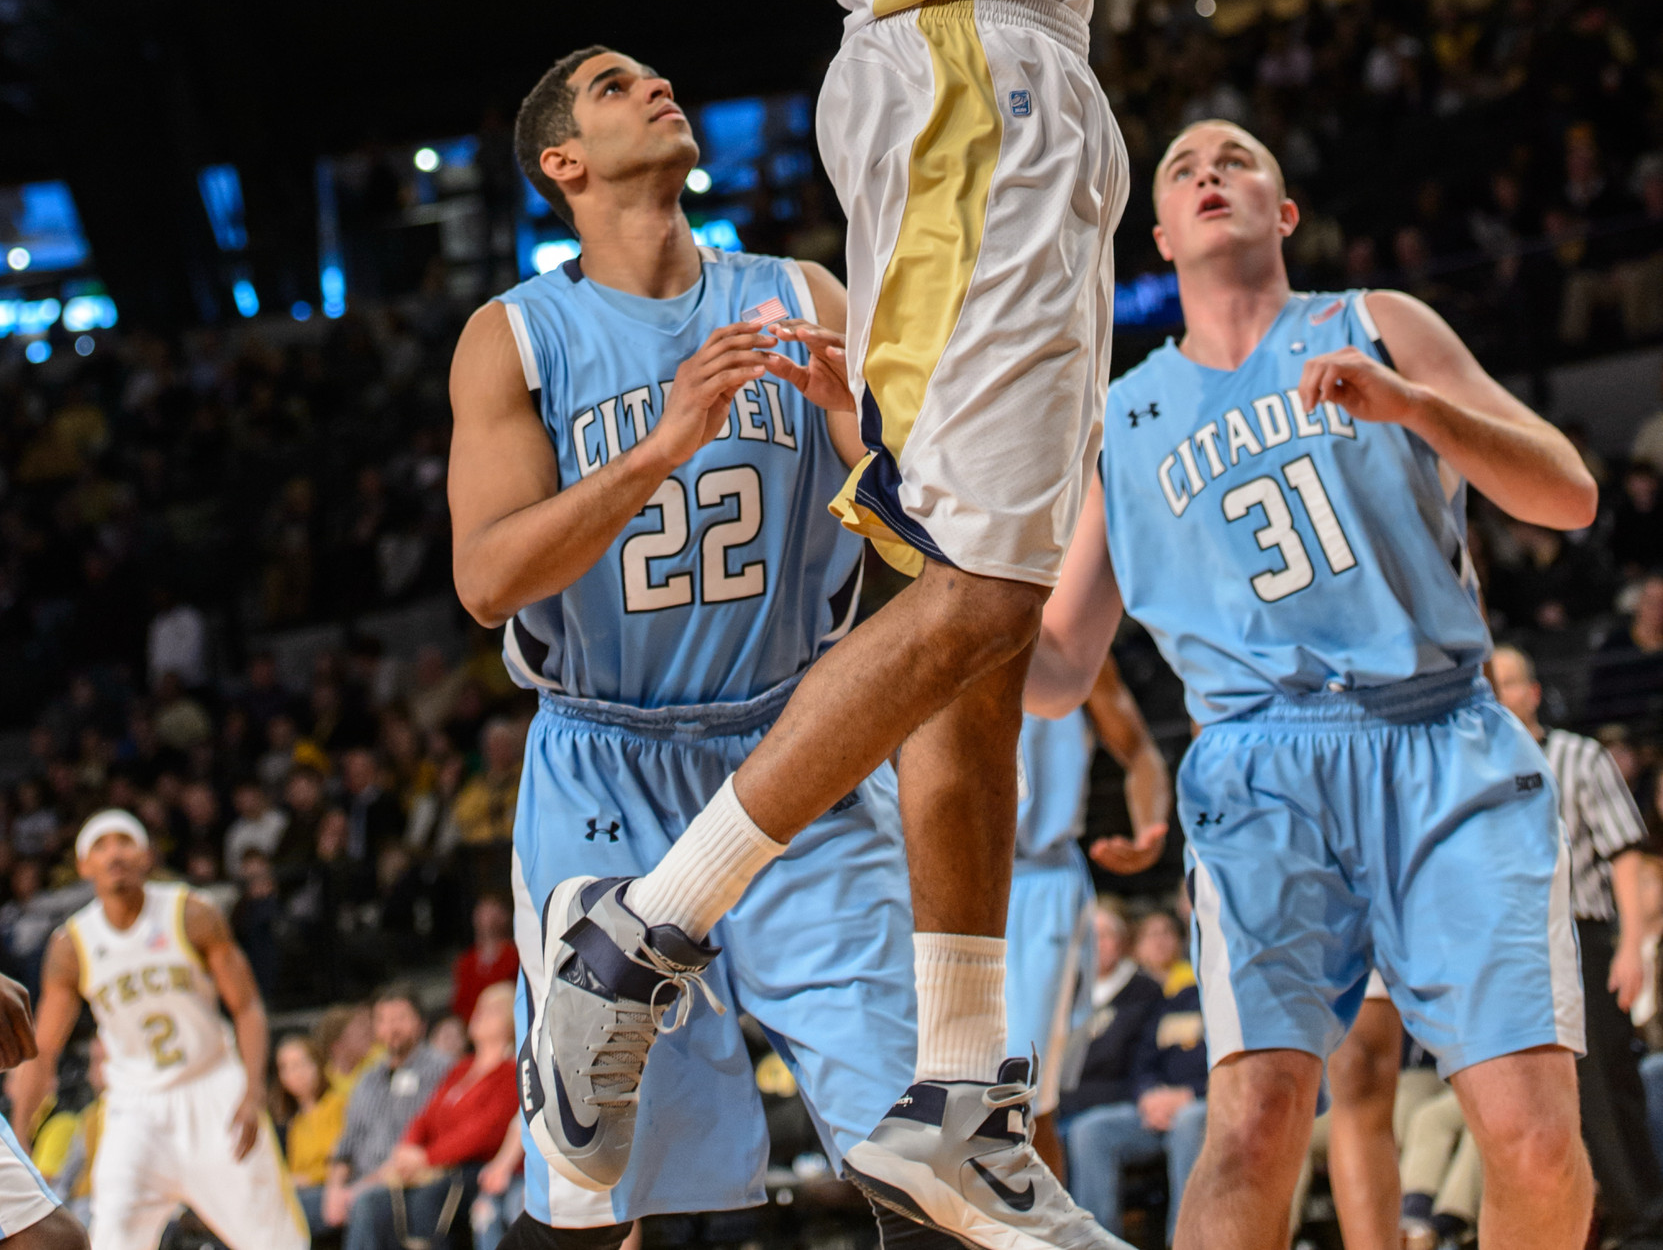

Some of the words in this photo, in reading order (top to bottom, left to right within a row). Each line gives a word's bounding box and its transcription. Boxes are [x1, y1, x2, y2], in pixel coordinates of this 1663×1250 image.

[572, 378, 799, 480] CITEL
[621, 463, 767, 615] 22
[1221, 452, 1358, 603] 31
[141, 1011, 186, 1069] 2
